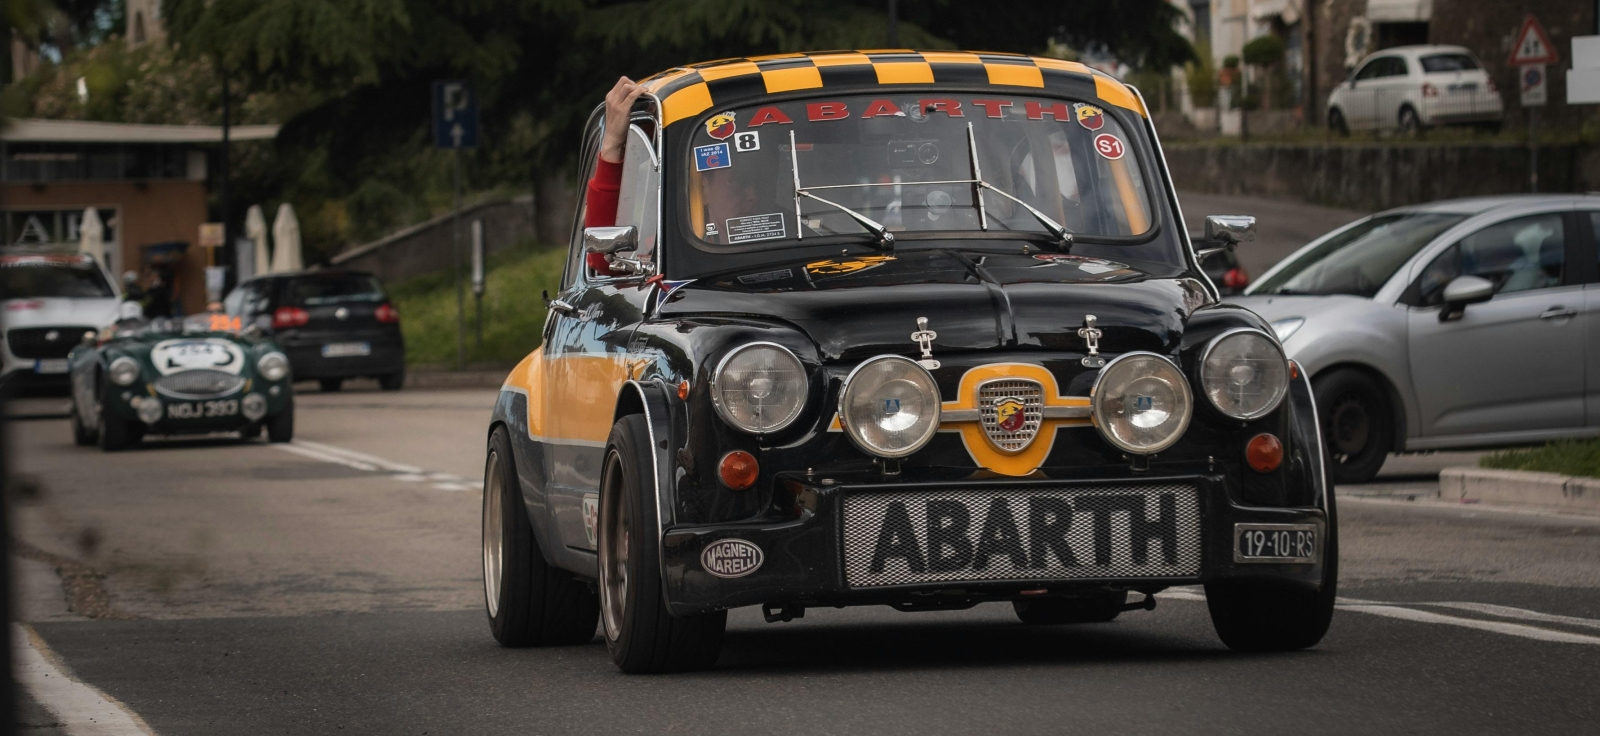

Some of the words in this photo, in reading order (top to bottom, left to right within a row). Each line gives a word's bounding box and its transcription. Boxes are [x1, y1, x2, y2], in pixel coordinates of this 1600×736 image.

[444, 83, 468, 121] P
[747, 98, 1070, 127] ABARTH
[738, 133, 757, 150] 8
[1098, 139, 1121, 154] S1
[707, 155, 720, 167] C
[869, 492, 1178, 574] ABARTH
[707, 543, 757, 562] MAGNETI
[1244, 530, 1313, 557] 19-10-RS
[707, 554, 757, 573] MARELLI
